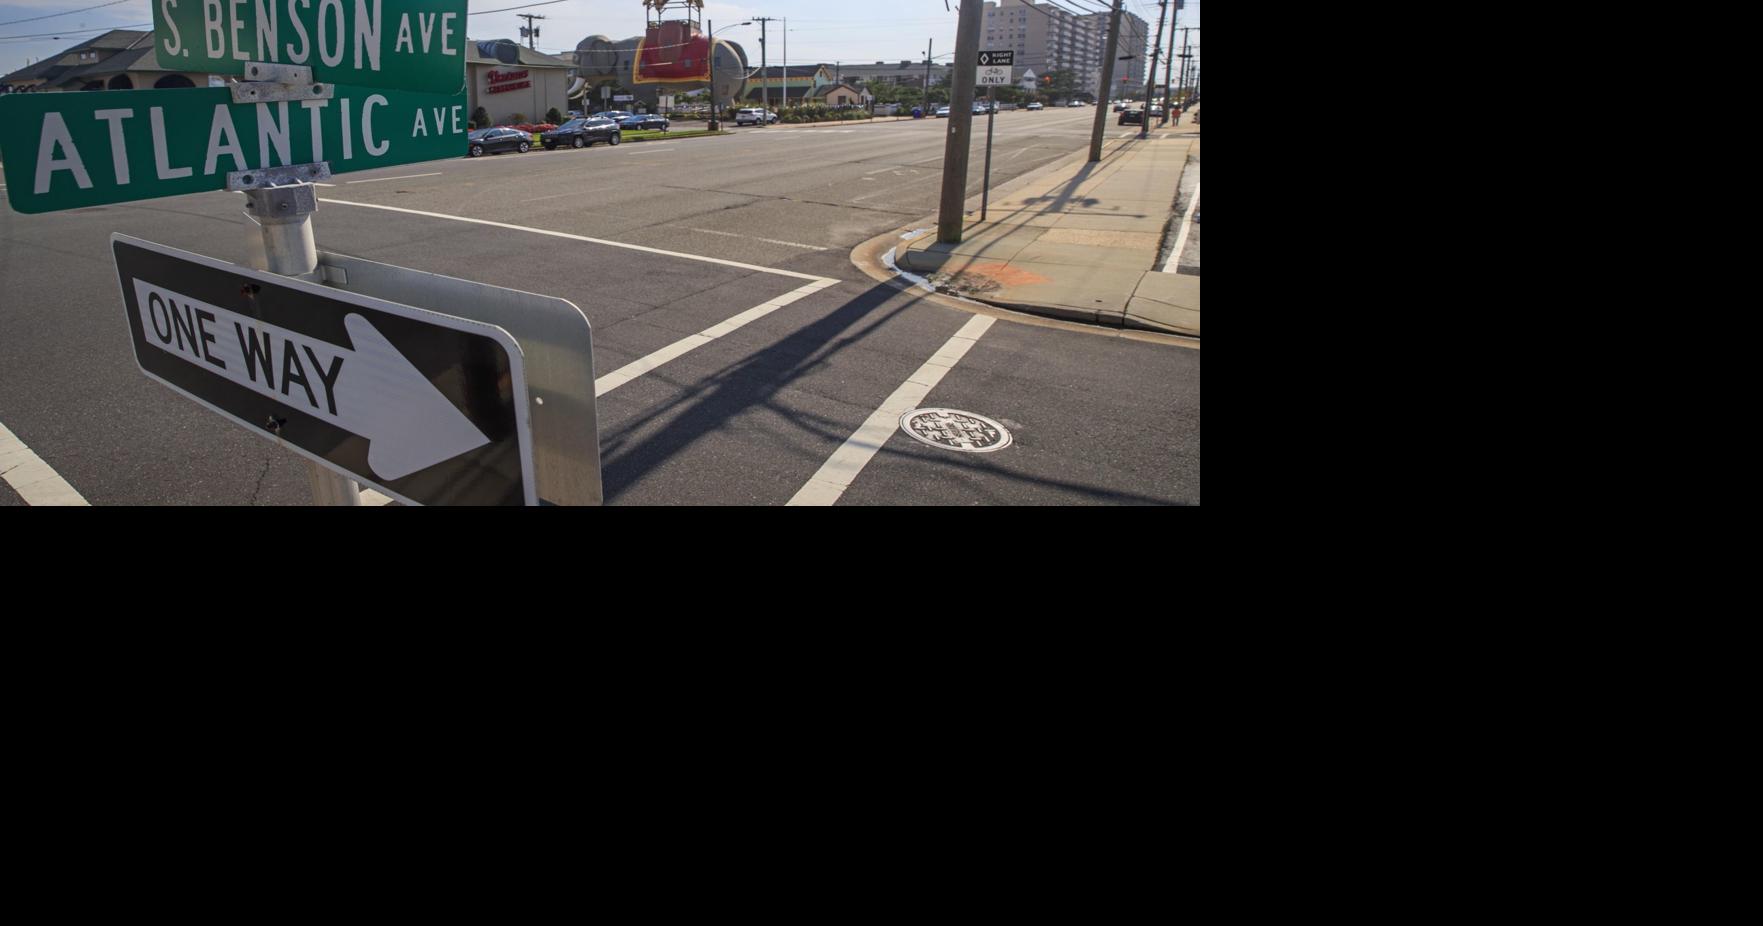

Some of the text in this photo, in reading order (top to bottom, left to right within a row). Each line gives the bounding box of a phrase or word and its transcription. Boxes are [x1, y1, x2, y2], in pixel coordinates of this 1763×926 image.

[161, 0, 457, 71] S. BENSON AVE
[33, 94, 463, 194] ATLANTIC AVE
[148, 291, 344, 416] ONE WAY
